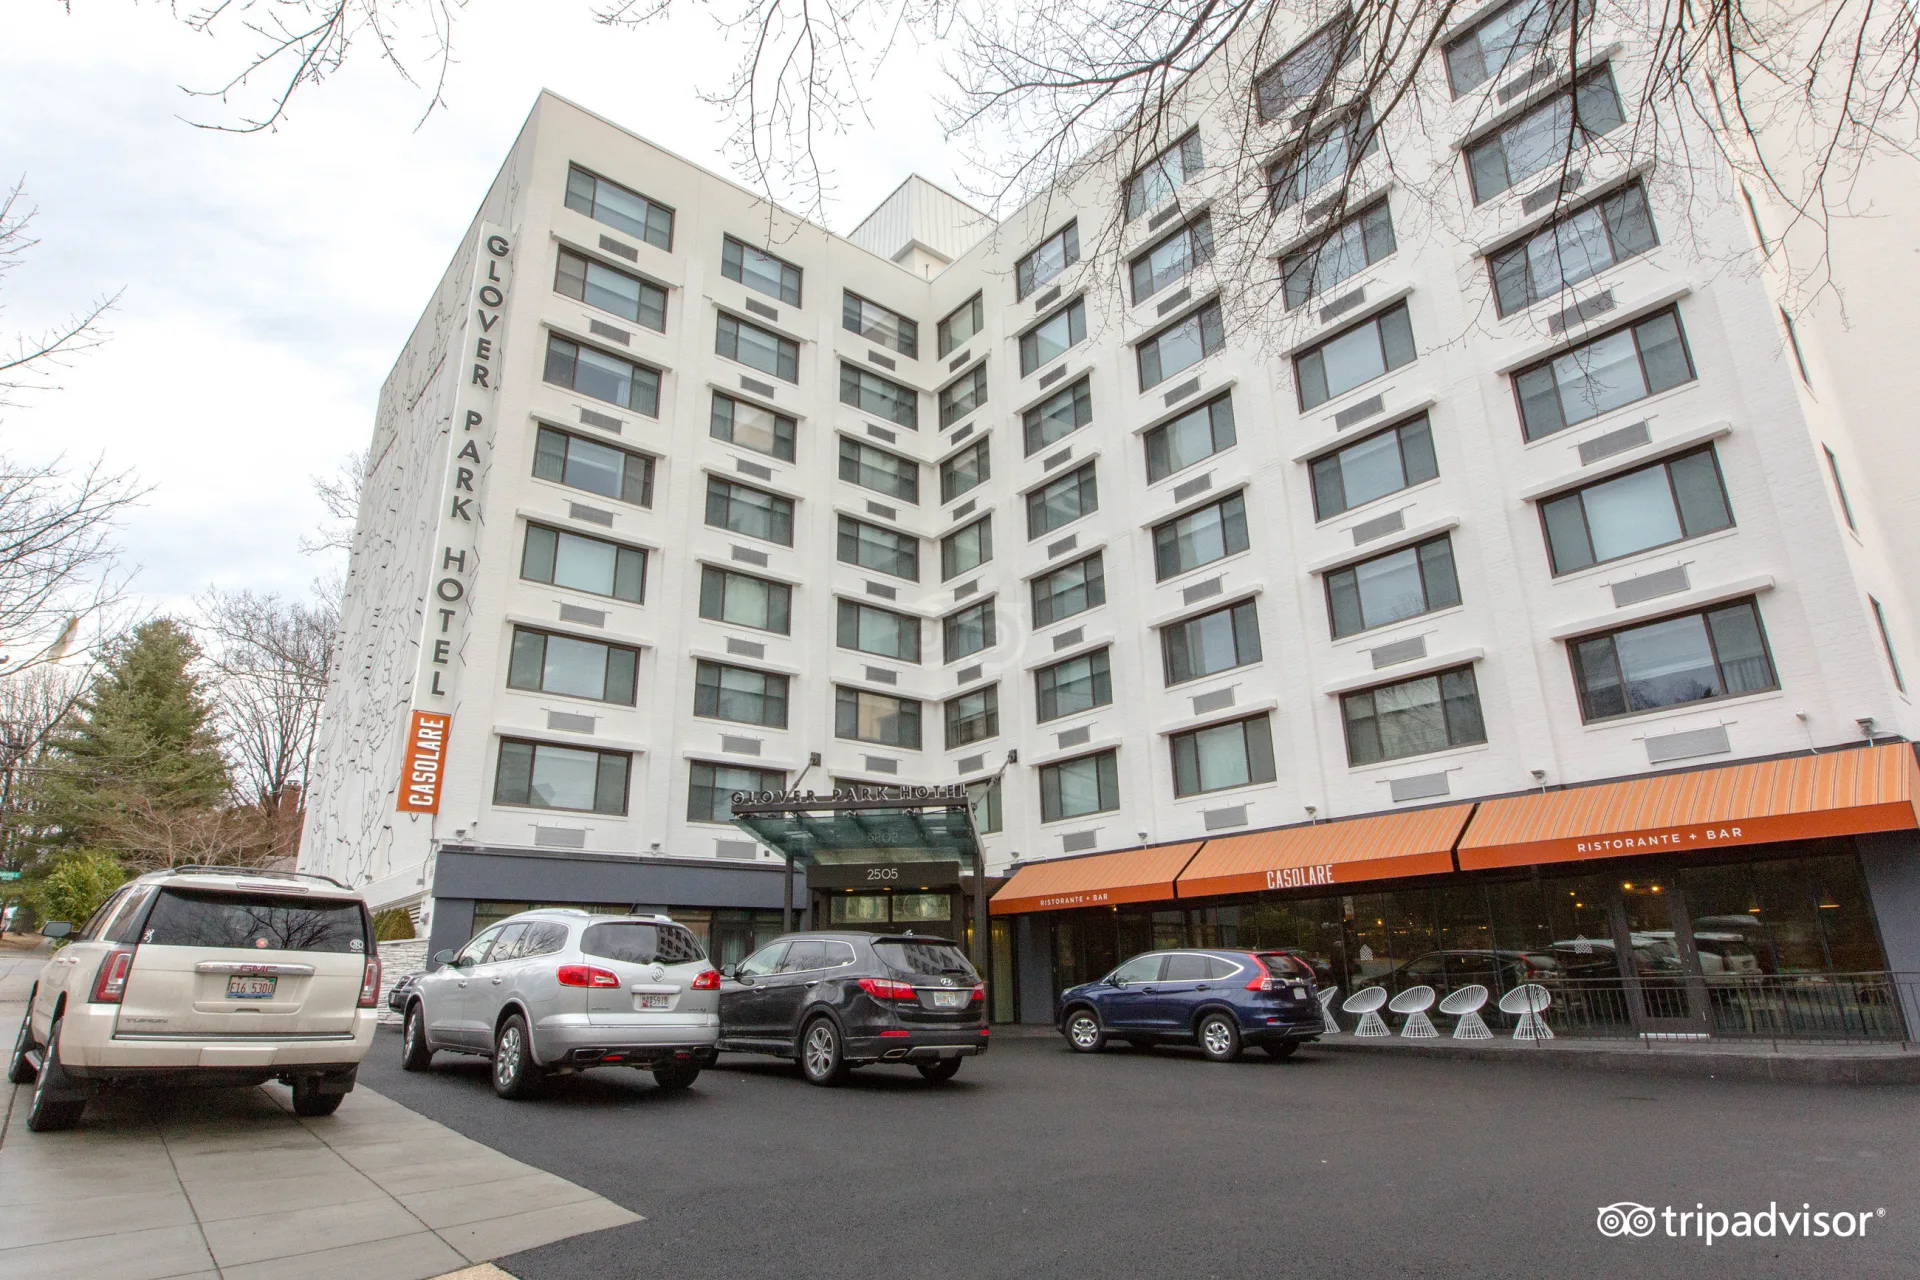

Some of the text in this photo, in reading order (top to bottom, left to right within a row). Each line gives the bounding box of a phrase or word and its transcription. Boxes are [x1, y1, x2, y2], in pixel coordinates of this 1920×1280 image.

[431, 235, 510, 697] GLOVER PARK HOTEL
[408, 716, 445, 807] CASOLARE
[731, 783, 970, 806] GLOVER PARK HOTEL
[1577, 833, 1681, 853] RISTORANTE
[1706, 827, 1743, 840] BAR
[867, 867, 899, 881] 2505
[1266, 864, 1335, 889] CASOLARE
[1040, 895, 1084, 907] RISTORANTE
[1093, 893, 1108, 901] BAR
[240, 964, 278, 973] GMC
